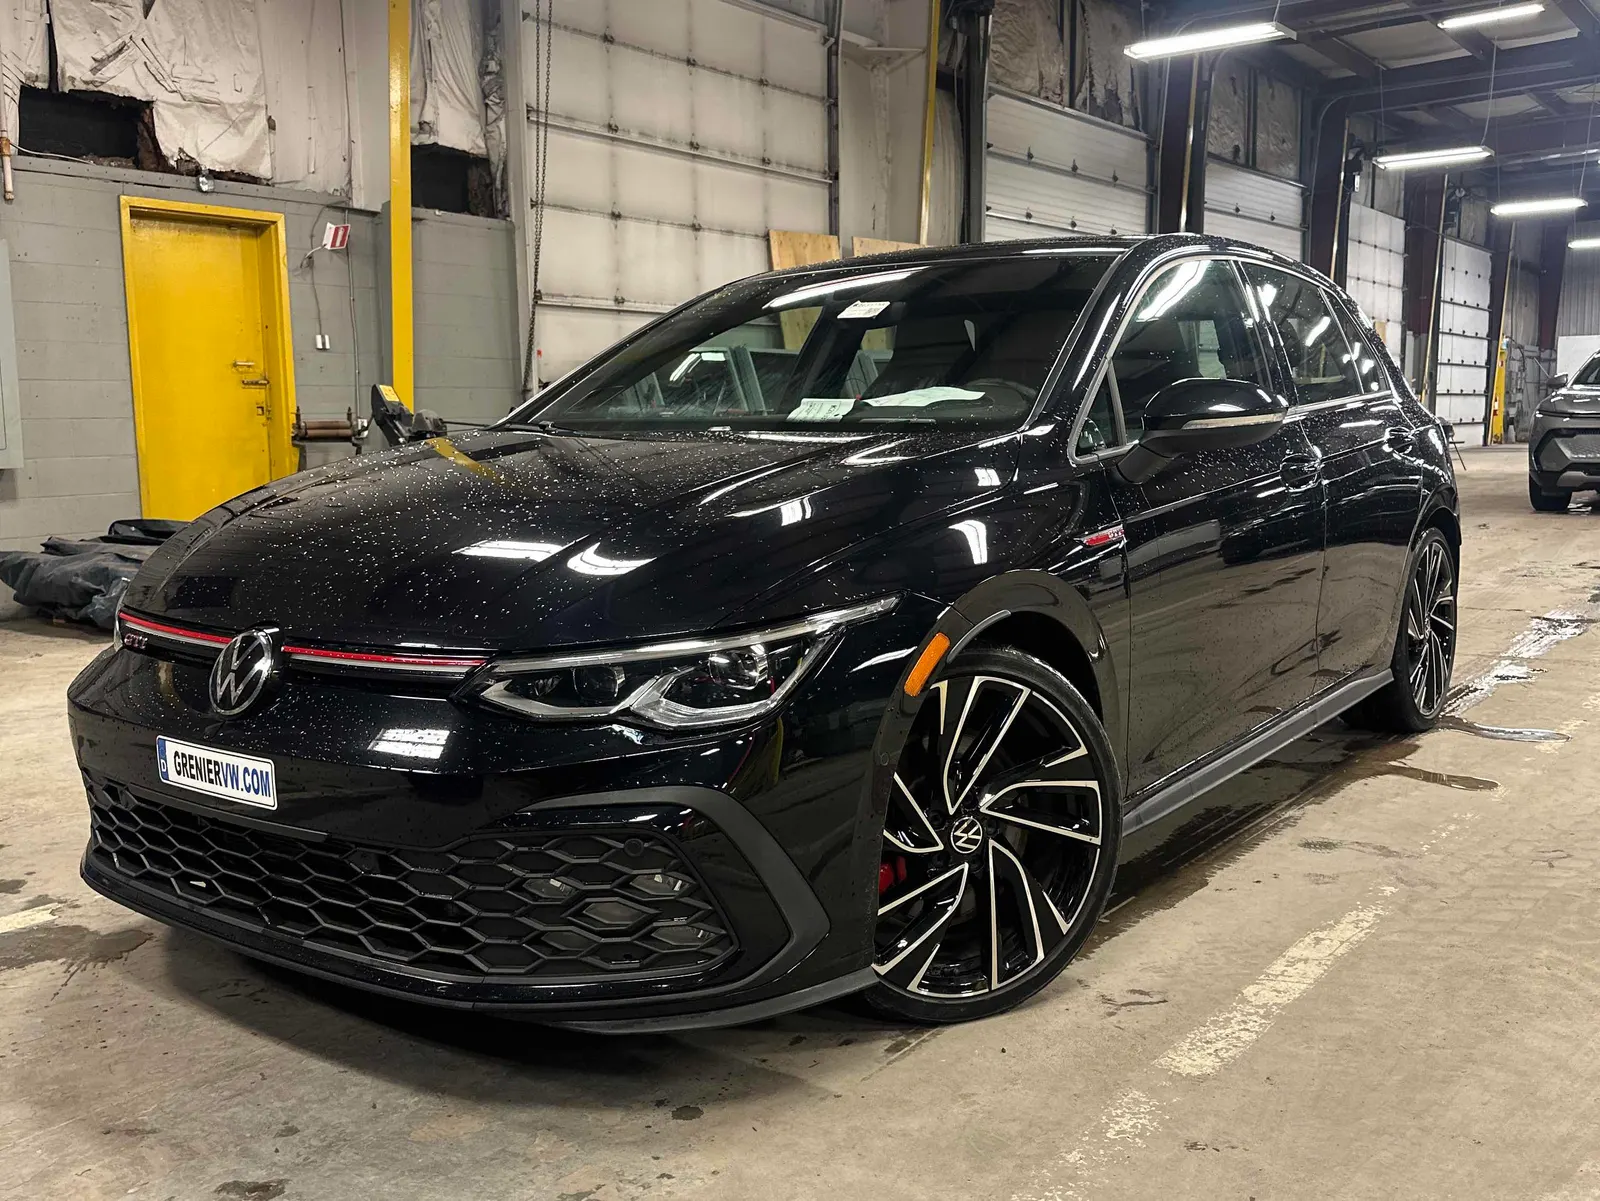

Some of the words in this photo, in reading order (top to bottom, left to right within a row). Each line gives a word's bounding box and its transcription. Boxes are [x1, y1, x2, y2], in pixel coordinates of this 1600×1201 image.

[124, 633, 148, 649] GTI
[160, 758, 167, 772] D
[173, 750, 271, 797] GRENIERVW.COM
